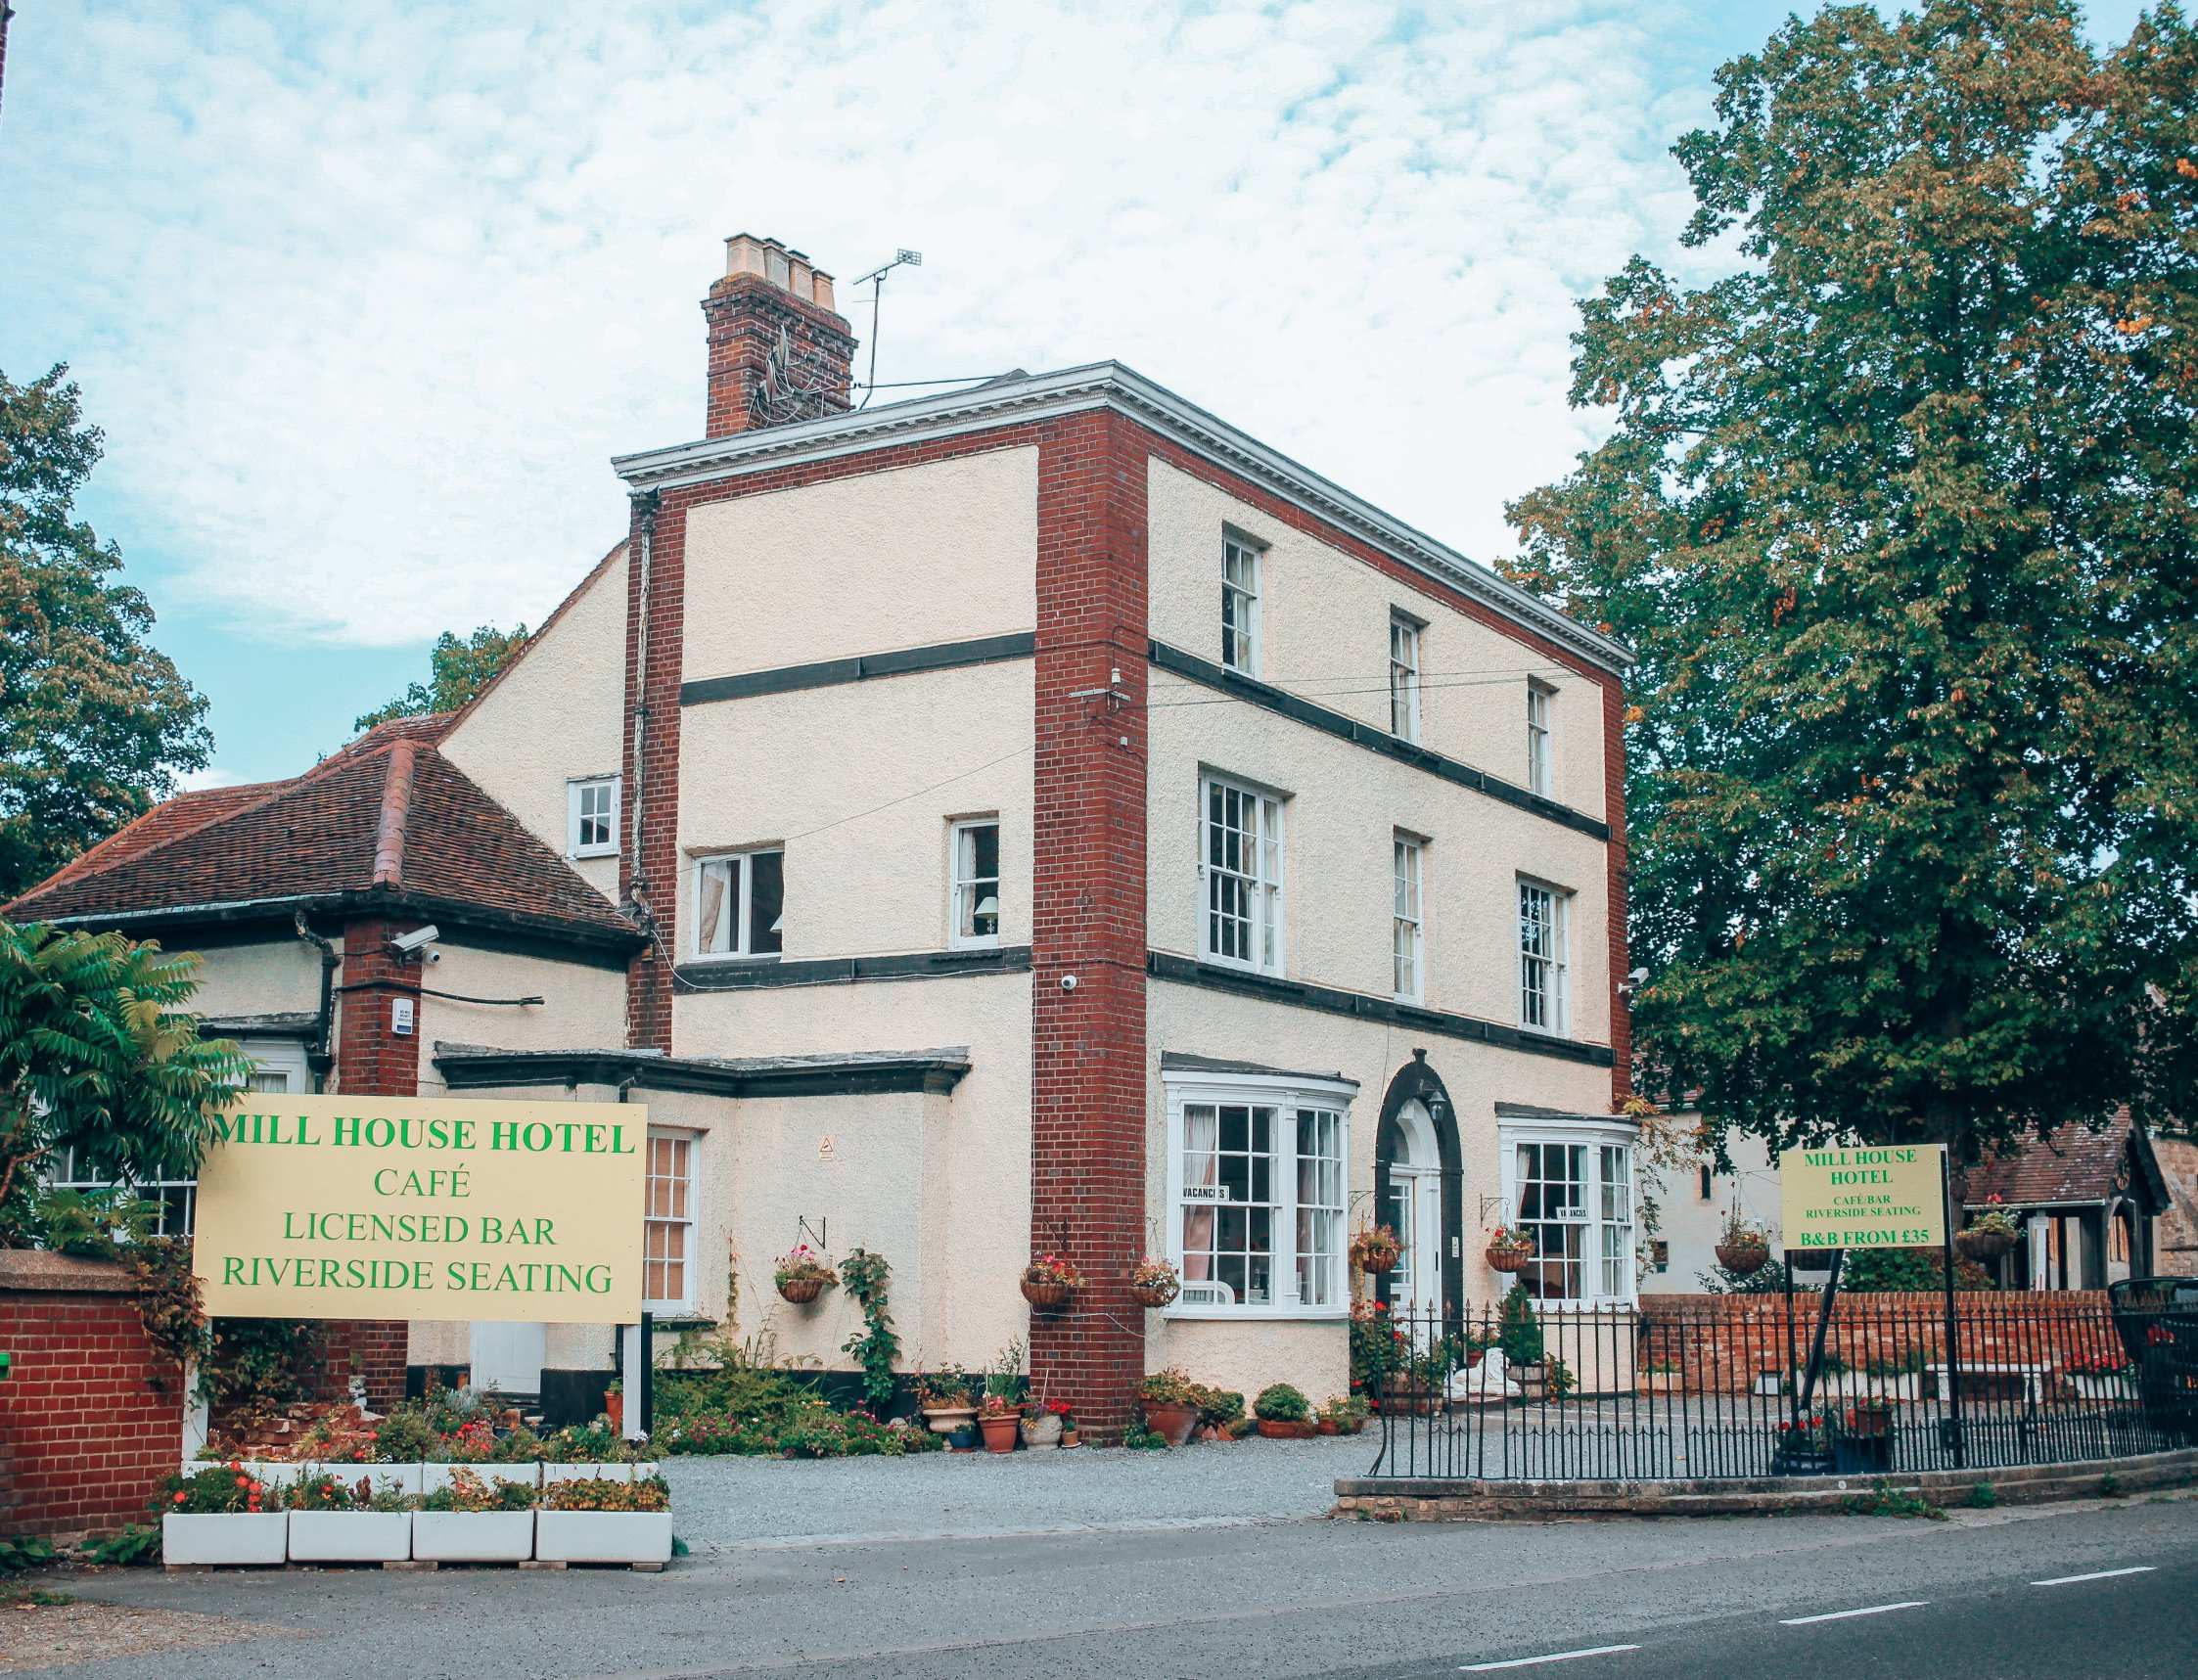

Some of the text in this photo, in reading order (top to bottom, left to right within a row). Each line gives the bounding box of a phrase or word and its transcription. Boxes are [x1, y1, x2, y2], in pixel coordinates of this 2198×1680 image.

[211, 1112, 636, 1155] MILL HOUSE HOTEL
[1805, 1149, 1918, 1167] MILL HOUSE
[374, 1162, 472, 1198] CAFÉ
[1831, 1170, 1894, 1185] HOTEL
[1183, 1187, 1224, 1199] VACANCIS
[1806, 1205, 1921, 1219] RIVERSIDE SEATING
[283, 1212, 558, 1246] LICENSED BAR
[1801, 1229, 1930, 1246] B&B FROM £35
[222, 1256, 614, 1294] RIVERSIDE SEATING
